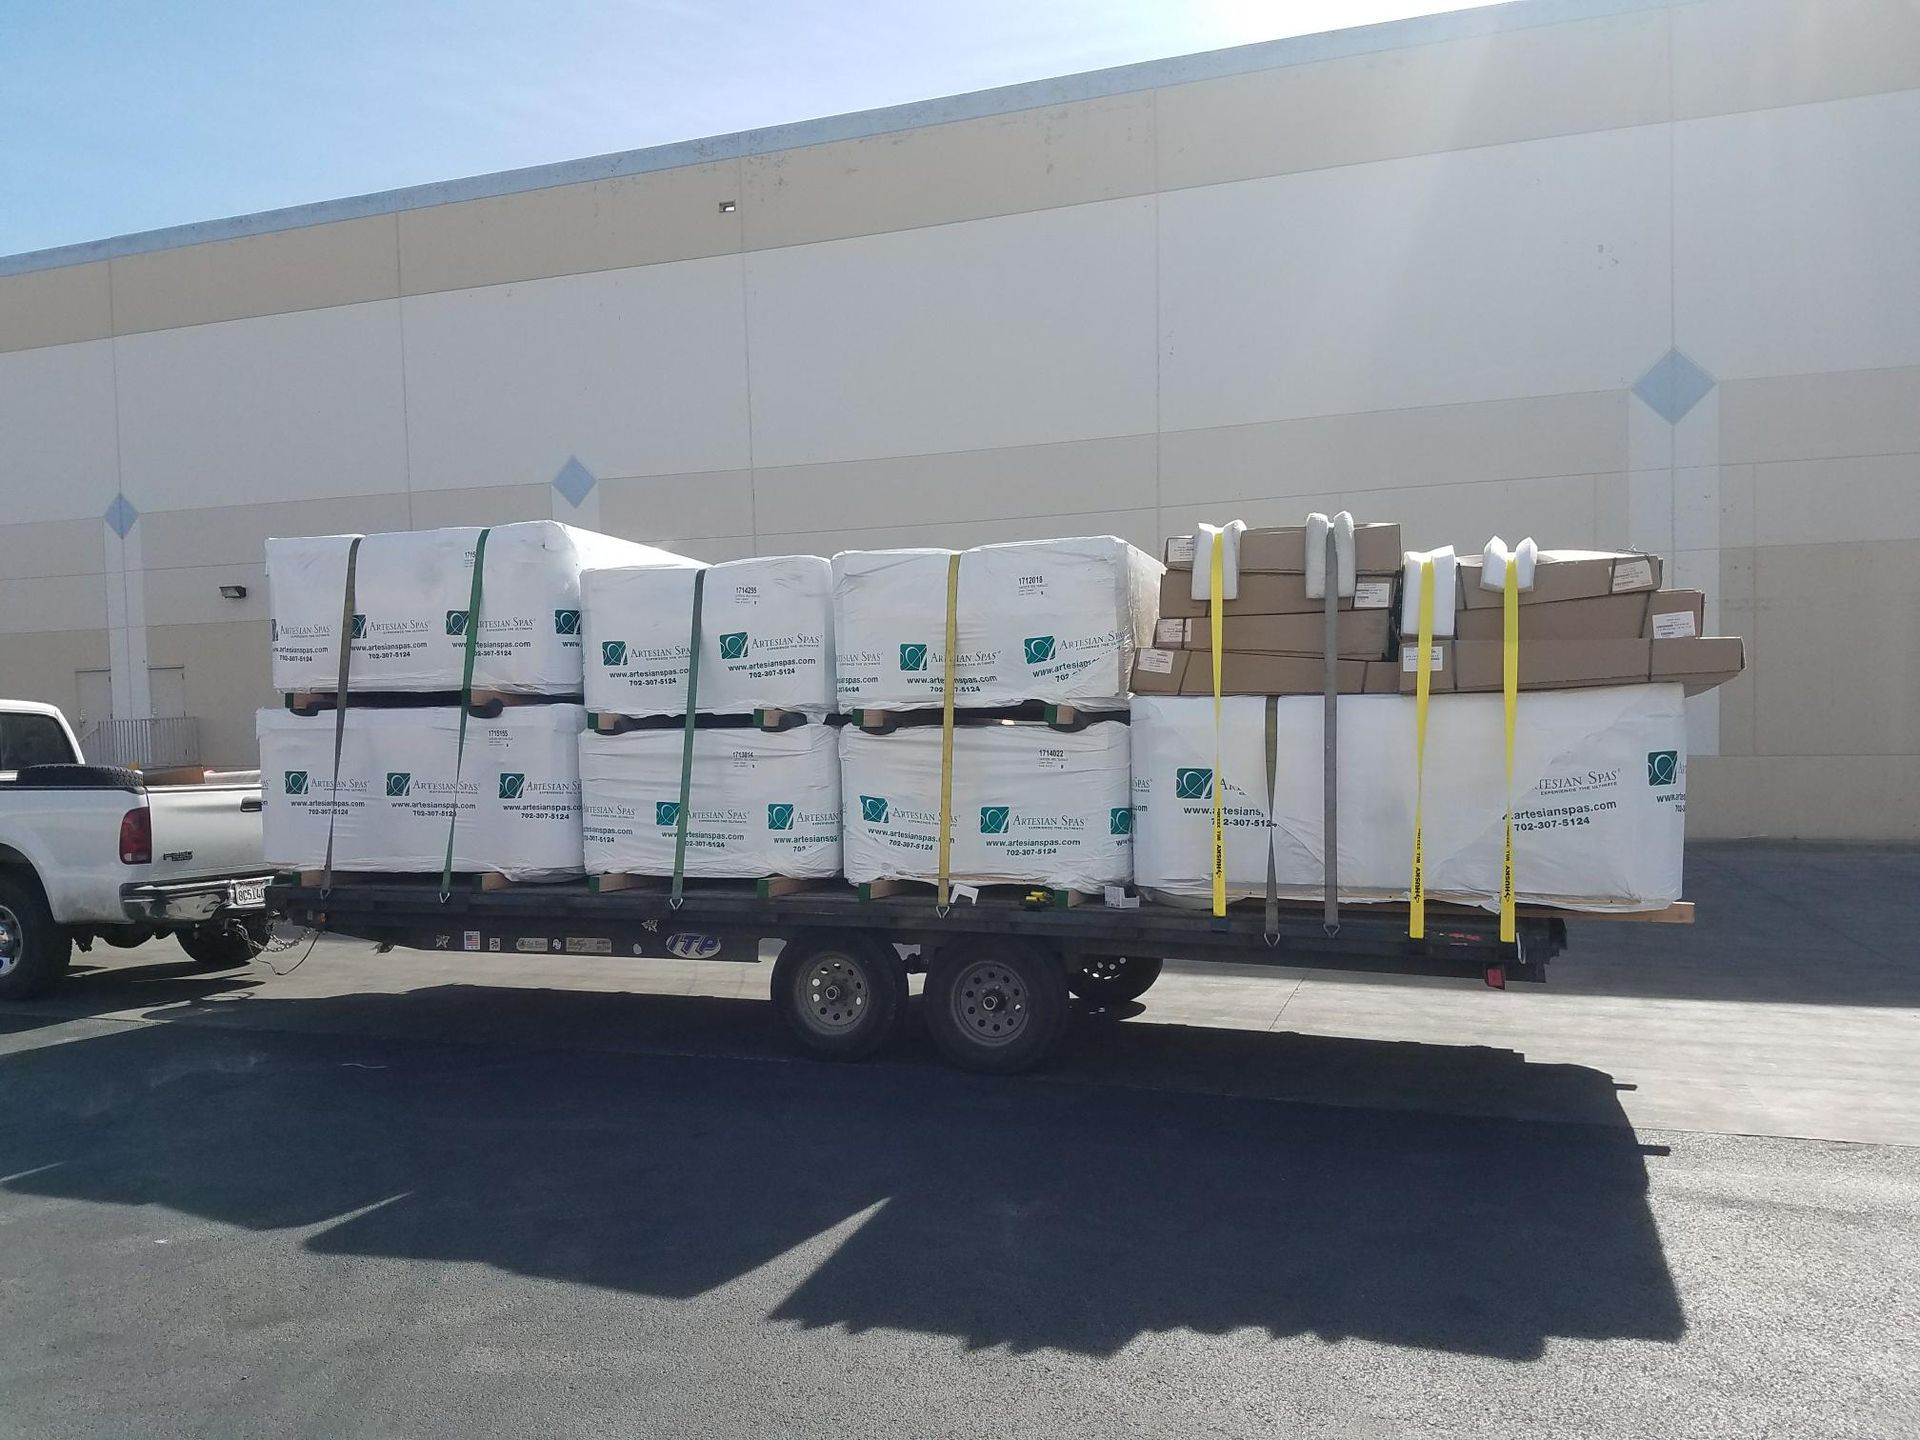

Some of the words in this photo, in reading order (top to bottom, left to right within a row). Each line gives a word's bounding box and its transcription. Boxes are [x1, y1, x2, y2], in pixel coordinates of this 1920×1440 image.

[477, 620, 511, 628] RTESIAN
[513, 617, 533, 627] SPAS
[752, 637, 794, 649] ARTESIAN
[797, 633, 820, 644] SPAS
[1060, 636, 1104, 650] ARTESIAN
[630, 648, 672, 658] ARTESIAN
[674, 645, 691, 655] SPA
[861, 651, 881, 661] SPAS
[930, 653, 971, 662] ARIAN
[975, 651, 997, 661] SPAS
[728, 657, 816, 671] www.artesianspas.com
[609, 668, 689, 678] www.artesianspas.co
[749, 668, 796, 678] 702-307-5124
[629, 678, 677, 686] 702-307-5124
[907, 675, 998, 684] www.artenspas.com
[349, 778, 367, 788] SPAS
[413, 779, 455, 790] ARTESIAN
[1535, 777, 1583, 790] TESIAN
[1588, 770, 1618, 784] SPAS
[526, 781, 569, 792] ARTESIAN
[503, 803, 582, 812] www.artesianspas.co
[617, 804, 635, 815] SPAS
[1502, 800, 1618, 820] .artesianspas.com
[727, 809, 747, 820] SPAS
[797, 811, 840, 822] ARTESIAN
[893, 807, 935, 821] ARTESIAN
[1013, 815, 1058, 826] ARTESIAN
[1062, 815, 1085, 826] SPAS
[1514, 816, 1591, 831] 702-307-5124
[889, 839, 934, 850] 702-307-5124
[986, 839, 1081, 847] www.artesianspas.com
[1006, 848, 1057, 856] 702-307-5124
[668, 934, 719, 955] ITP
